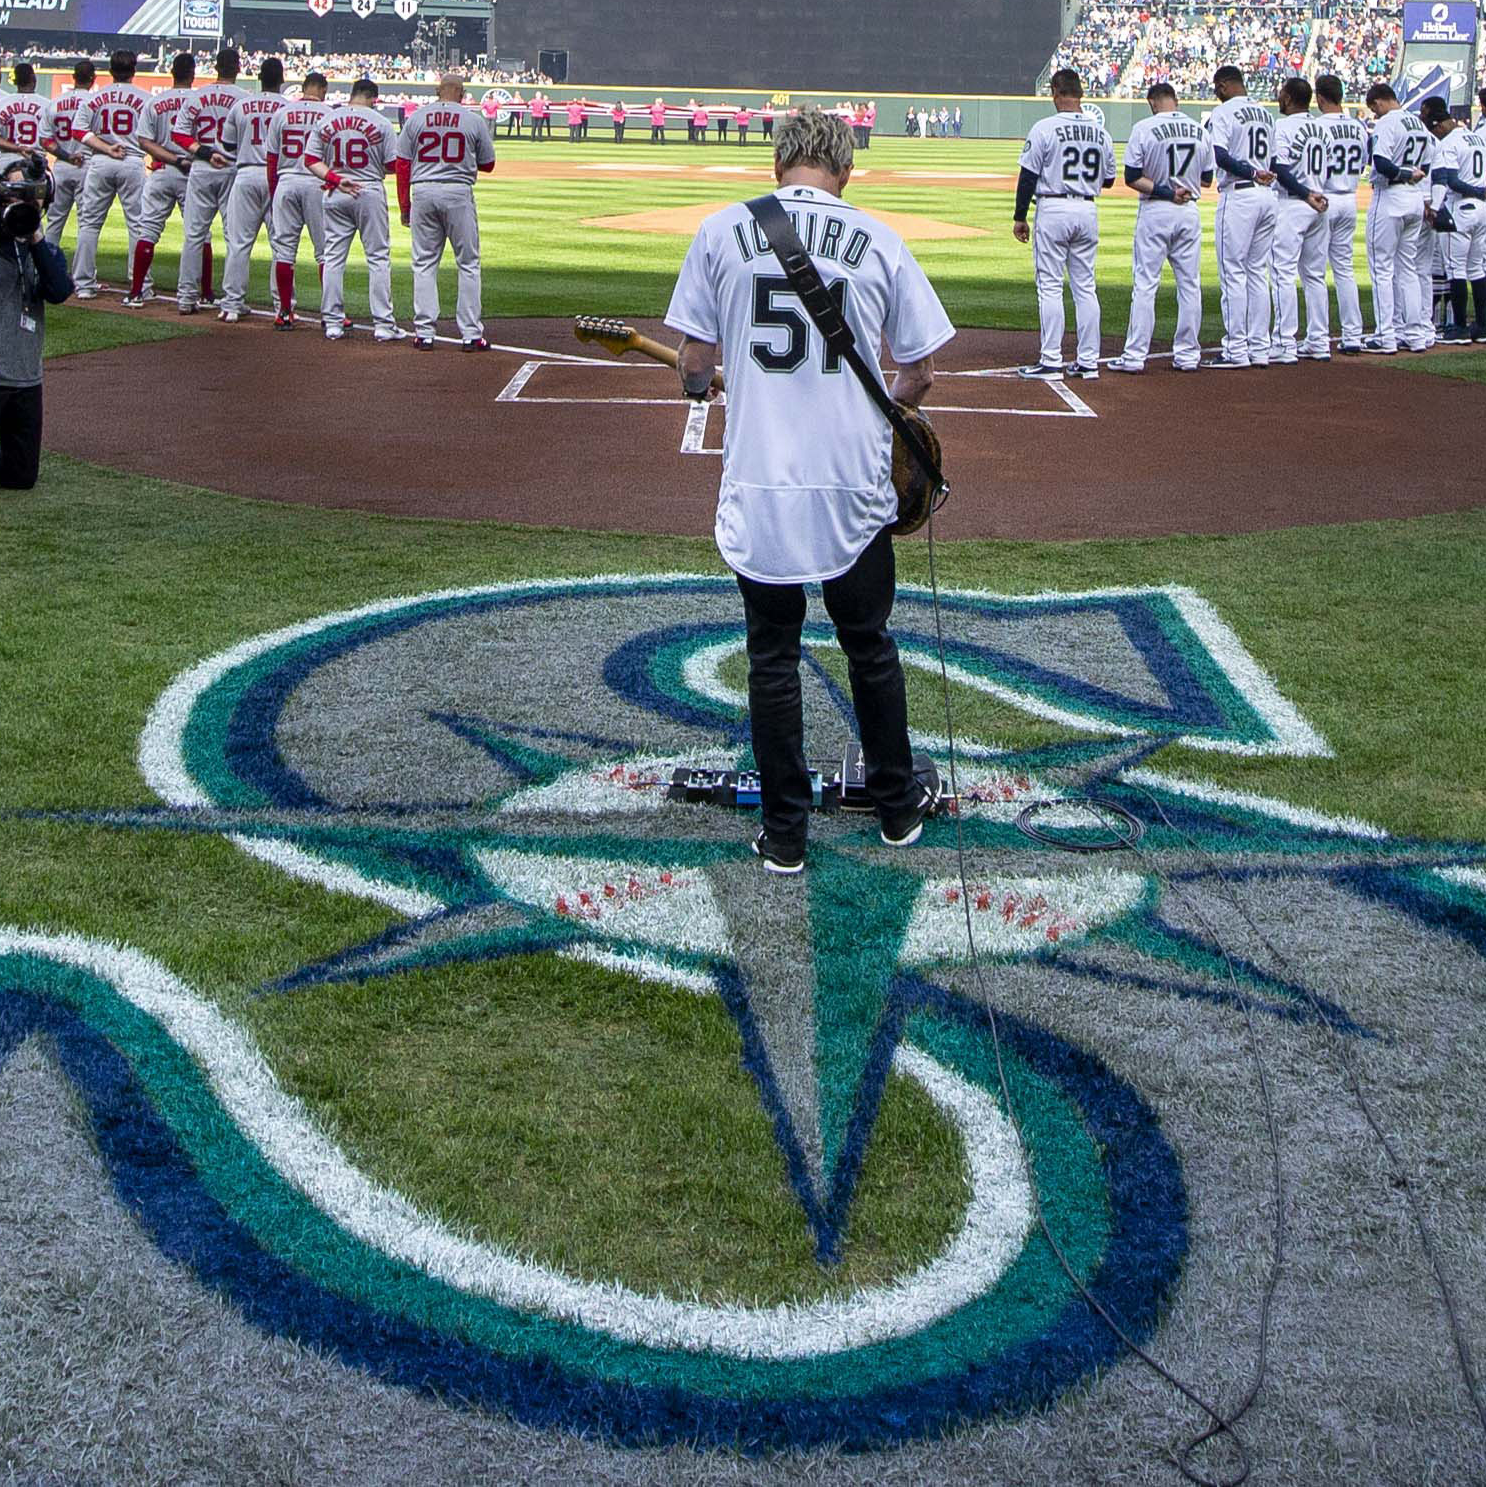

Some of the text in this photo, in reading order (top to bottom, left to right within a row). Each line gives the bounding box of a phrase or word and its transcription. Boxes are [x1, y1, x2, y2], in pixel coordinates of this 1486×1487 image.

[357, 0, 371, 11] 24
[401, 1, 411, 13] 11
[184, 17, 219, 30] TOUGH
[1412, 30, 1448, 41] America
[1422, 21, 1457, 32] Holland
[771, 94, 790, 106] 401
[7, 120, 38, 145] 19
[100, 108, 133, 136] 18
[426, 111, 460, 129] CORA
[1152, 122, 1204, 143] HANIGER
[1056, 124, 1106, 147] SERVAIS
[1247, 127, 1269, 160] 16
[1329, 125, 1361, 141] BRUCE
[331, 136, 370, 169] 16
[417, 131, 465, 164] 20
[1166, 143, 1197, 177] 17
[1306, 144, 1323, 176] 10
[1332, 144, 1363, 176] 32
[1403, 135, 1428, 165] 27
[1063, 146, 1102, 181] 29
[1472, 150, 1483, 178] 0
